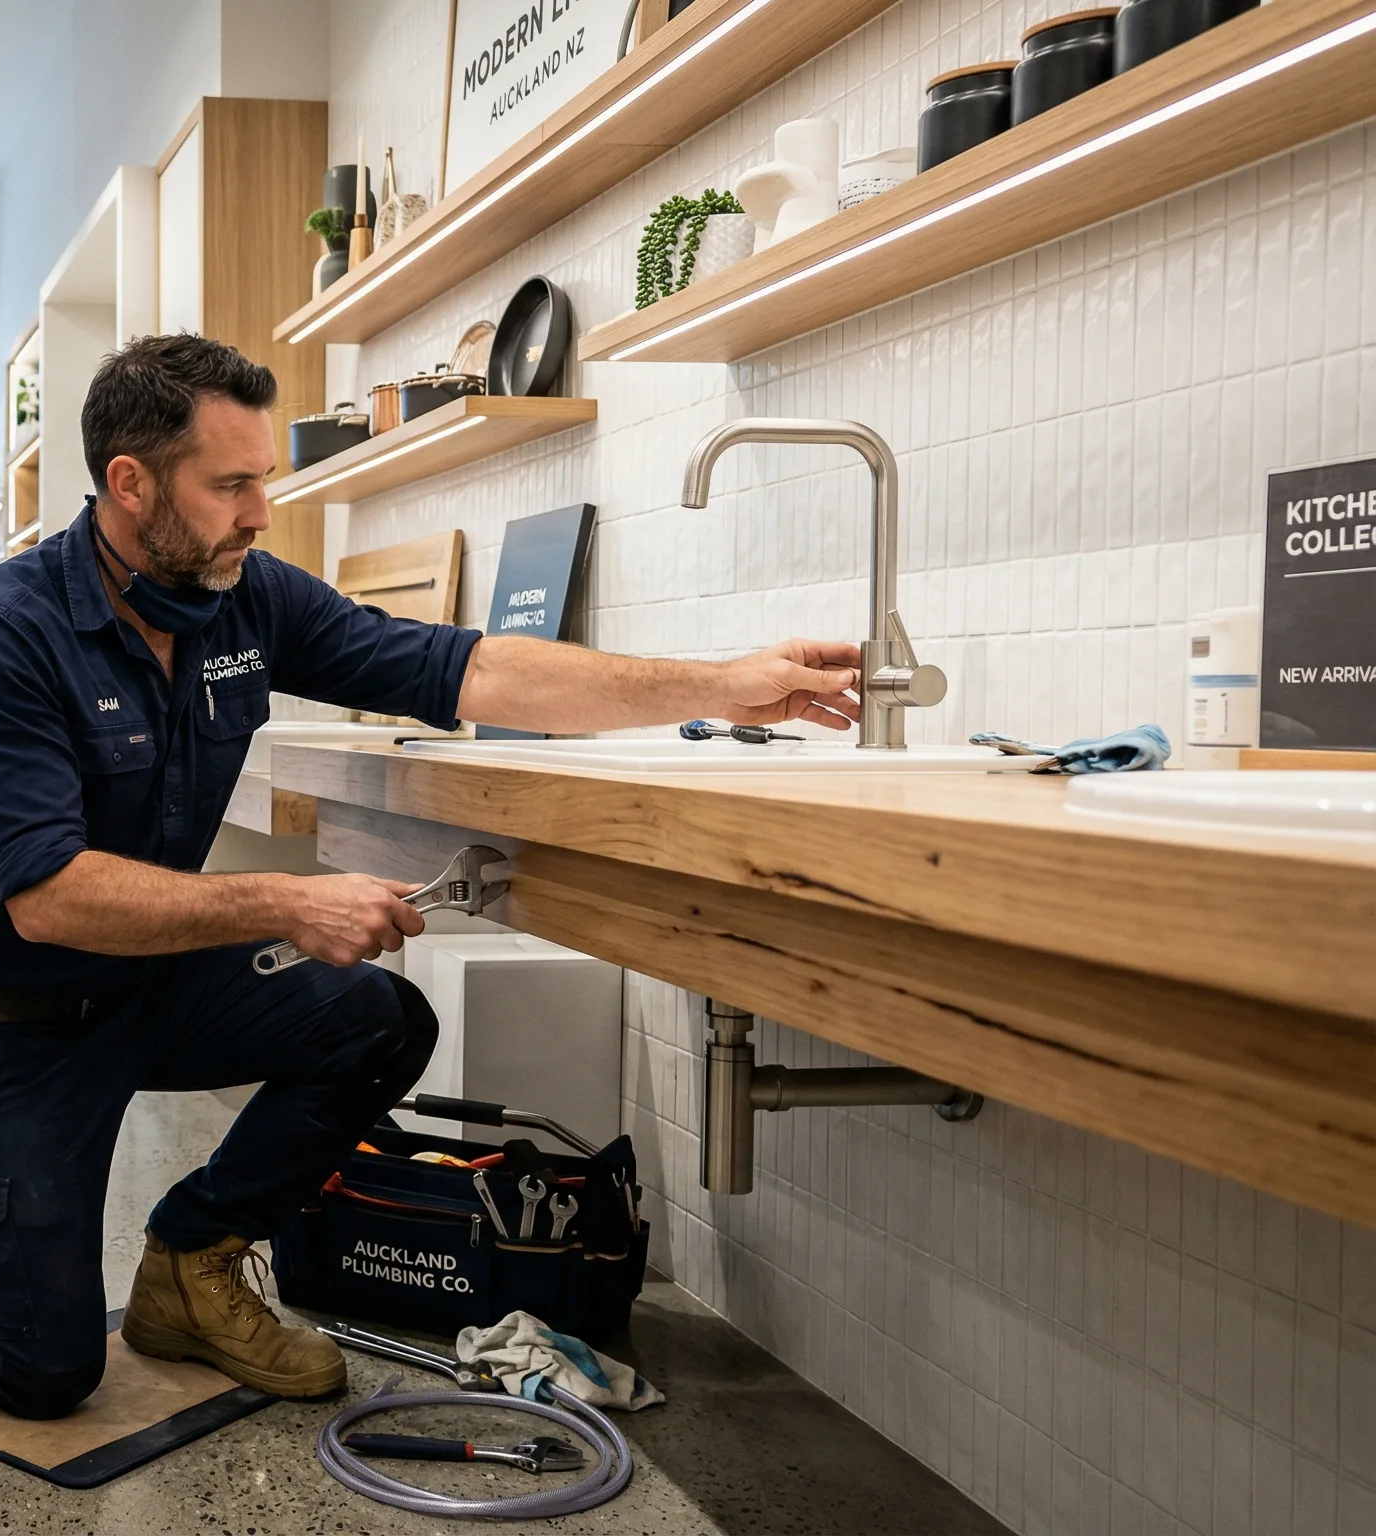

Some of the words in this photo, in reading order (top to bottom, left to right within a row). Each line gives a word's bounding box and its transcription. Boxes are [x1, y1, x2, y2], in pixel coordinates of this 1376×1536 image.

[463, 0, 543, 100] MODERN
[489, 49, 561, 125] AUCKLAND
[566, 26, 585, 64] NZ
[1285, 523, 1376, 557] COLLE
[1279, 667, 1318, 684] NEW
[354, 1240, 457, 1271] AUCKLAND
[342, 1256, 435, 1289] PLUMBING
[441, 1275, 474, 1294] CO.
